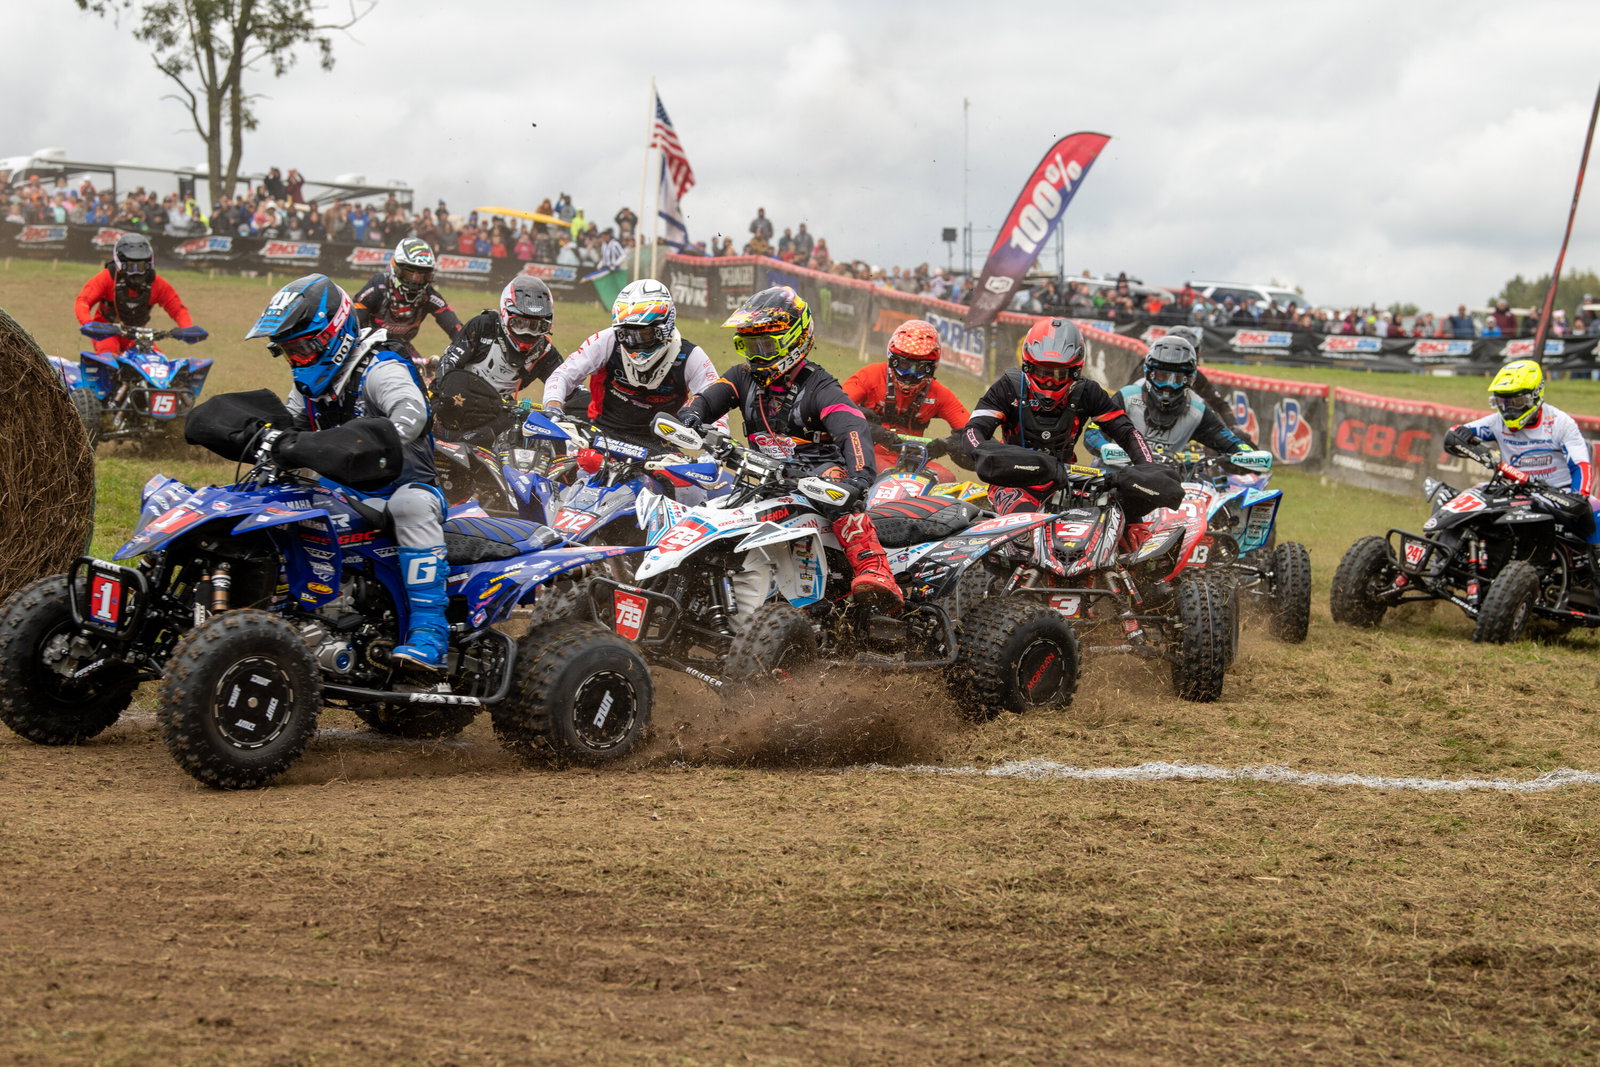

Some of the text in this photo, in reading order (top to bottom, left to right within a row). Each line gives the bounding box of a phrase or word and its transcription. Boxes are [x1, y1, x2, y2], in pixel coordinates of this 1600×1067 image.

[1010, 152, 1083, 255] 100%
[263, 241, 321, 258] AMSOIL
[438, 255, 492, 273] AMSOIL
[779, 348, 801, 370] 733
[153, 395, 175, 413] 15
[1335, 418, 1433, 463] GBC
[1501, 463, 1525, 480] Mika
[554, 511, 592, 532] 712
[760, 507, 790, 522] KENDA
[995, 513, 1032, 527] 733
[337, 530, 379, 545] GBC
[1056, 524, 1090, 536] 3
[1407, 545, 1424, 562] 241
[407, 556, 438, 586] G
[97, 582, 113, 618] 1
[1050, 596, 1081, 616] 3
[616, 602, 643, 629] 733
[685, 666, 724, 687] HOUSER
